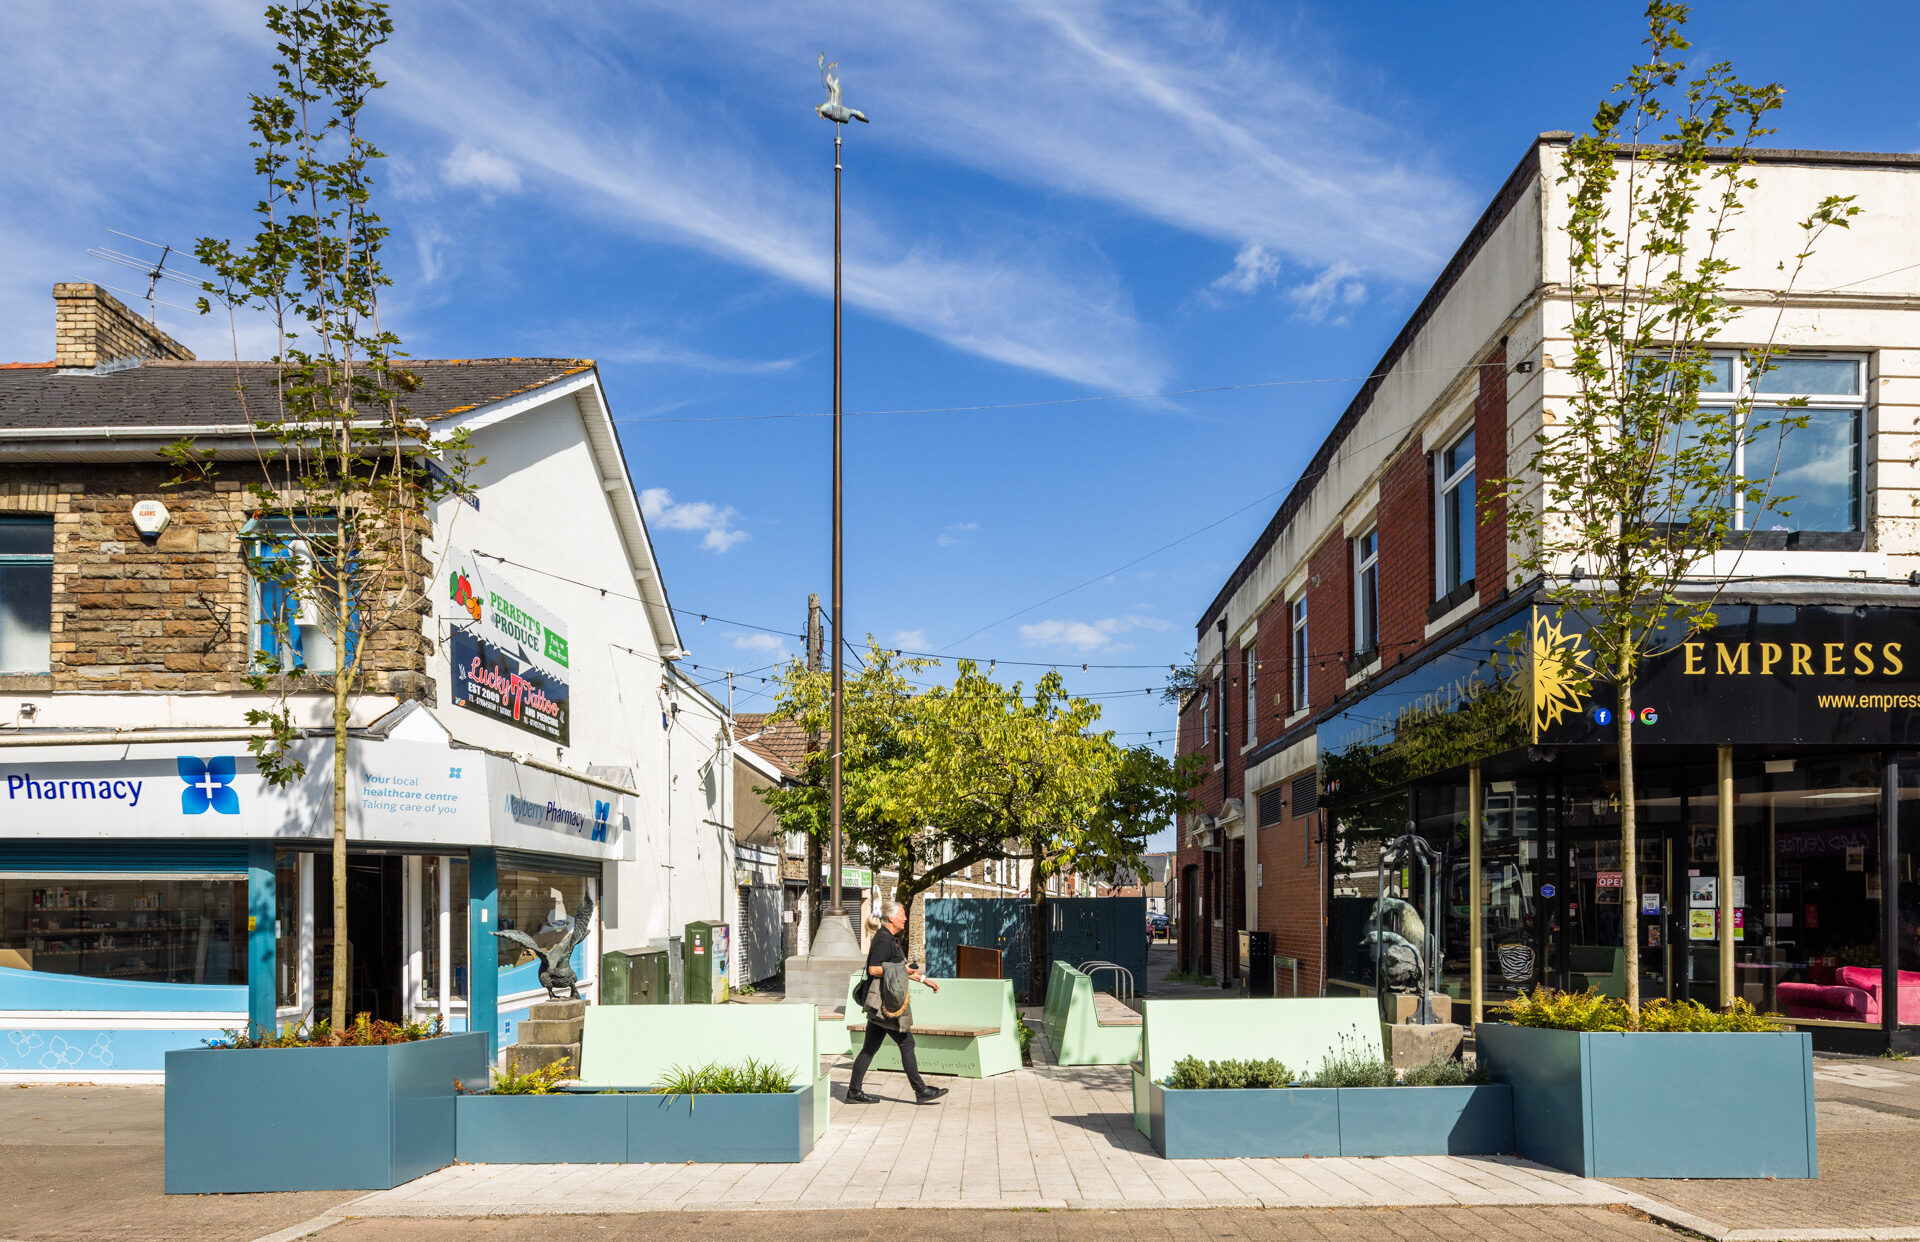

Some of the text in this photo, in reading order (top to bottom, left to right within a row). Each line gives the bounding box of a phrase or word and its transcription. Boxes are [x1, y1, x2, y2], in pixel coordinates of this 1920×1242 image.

[490, 591, 541, 636] PERRETT'S
[494, 612, 540, 652] PRODUCE
[1683, 642, 1904, 676] EMPRESS
[467, 656, 511, 706] Lucky
[510, 672, 523, 720] 7
[522, 680, 560, 717] Tattoo
[468, 681, 481, 695] EST
[1818, 693, 1920, 712] www.empress
[1340, 710, 1392, 757] EMPRESS
[1399, 669, 1479, 731] PIERCING
[7, 773, 142, 807] Pharmacy
[363, 786, 458, 802] healthcare centre
[365, 773, 419, 787] Your local
[362, 799, 457, 816] Taking care of you
[504, 793, 586, 833] Mayberry Pharmacy
